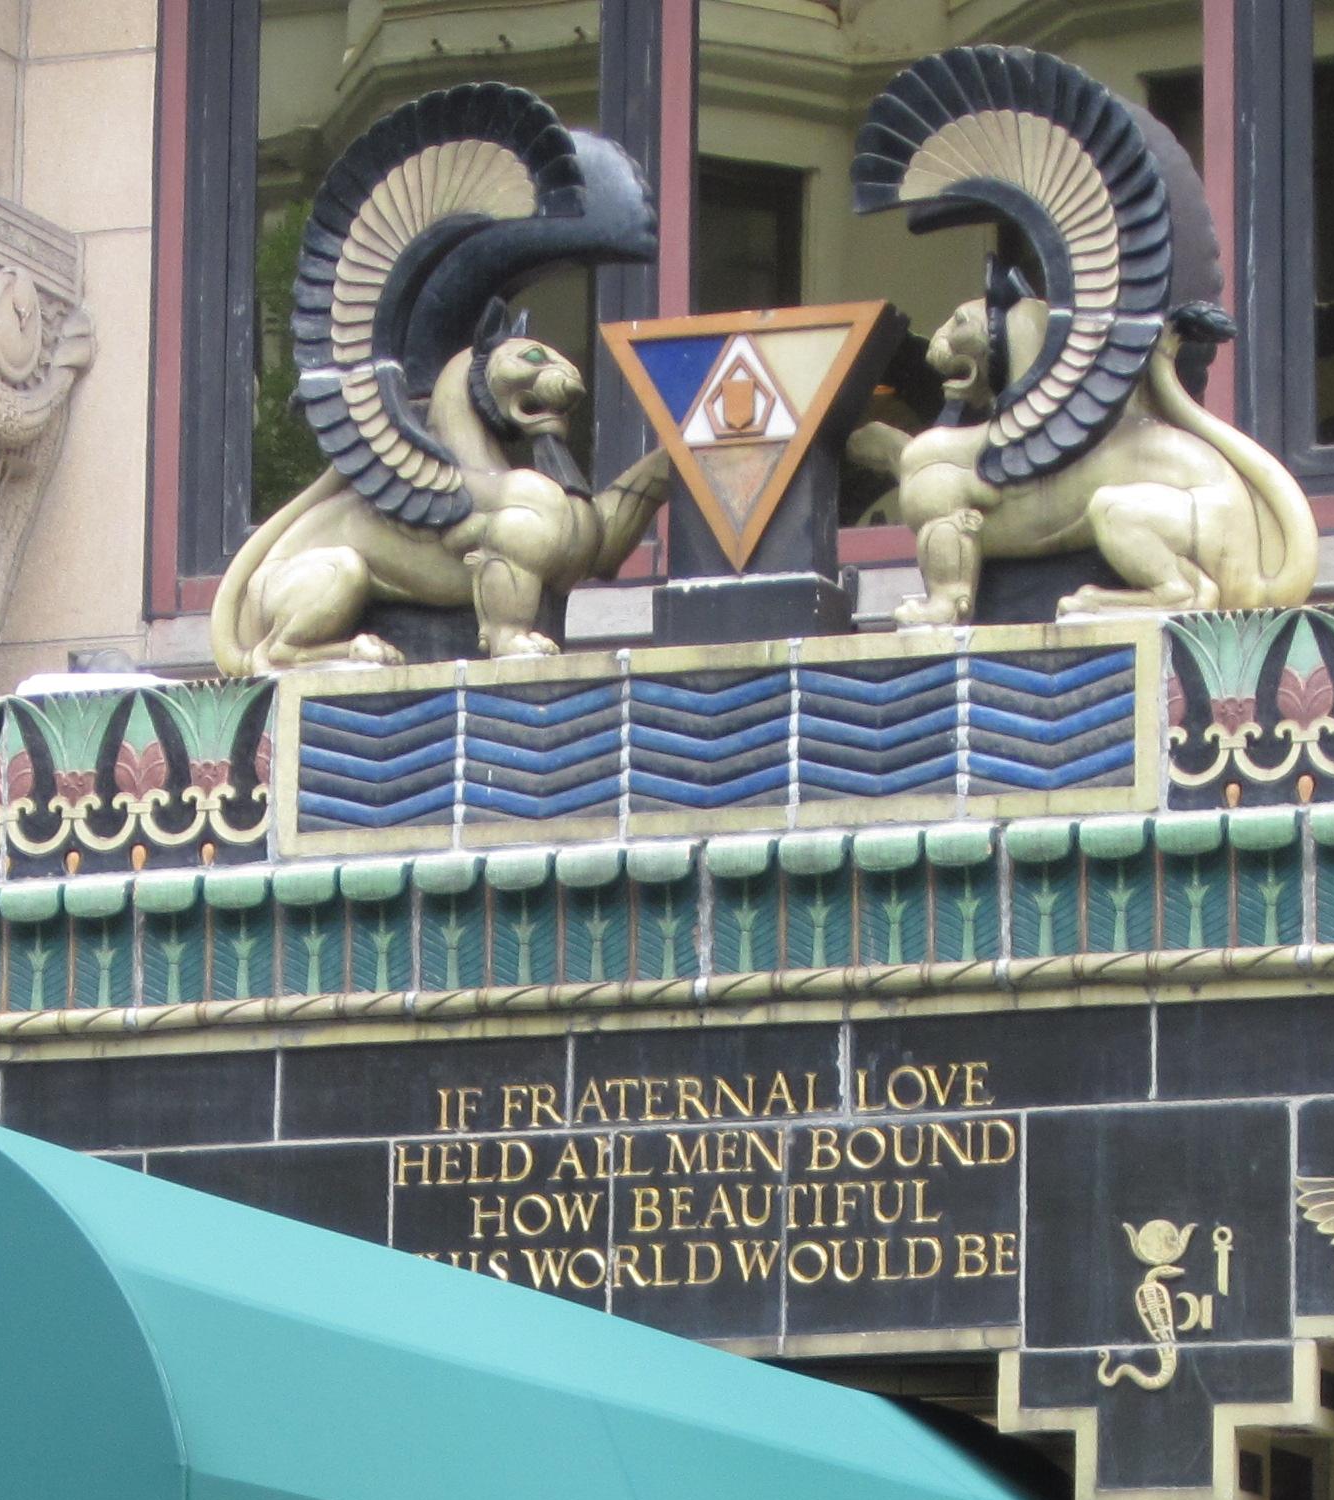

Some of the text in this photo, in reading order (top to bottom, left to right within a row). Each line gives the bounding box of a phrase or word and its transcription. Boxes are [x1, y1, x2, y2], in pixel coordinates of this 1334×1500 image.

[436, 1061, 996, 1132] IF FRATERNAL LOVE
[395, 1119, 1016, 1187] HELD ALL MEN BOUND
[469, 1179, 942, 1239] HOW BEAUTIFUL
[519, 1241, 722, 1290] WORLD
[730, 1234, 942, 1285] WOULD
[954, 1231, 1018, 1279] BE
